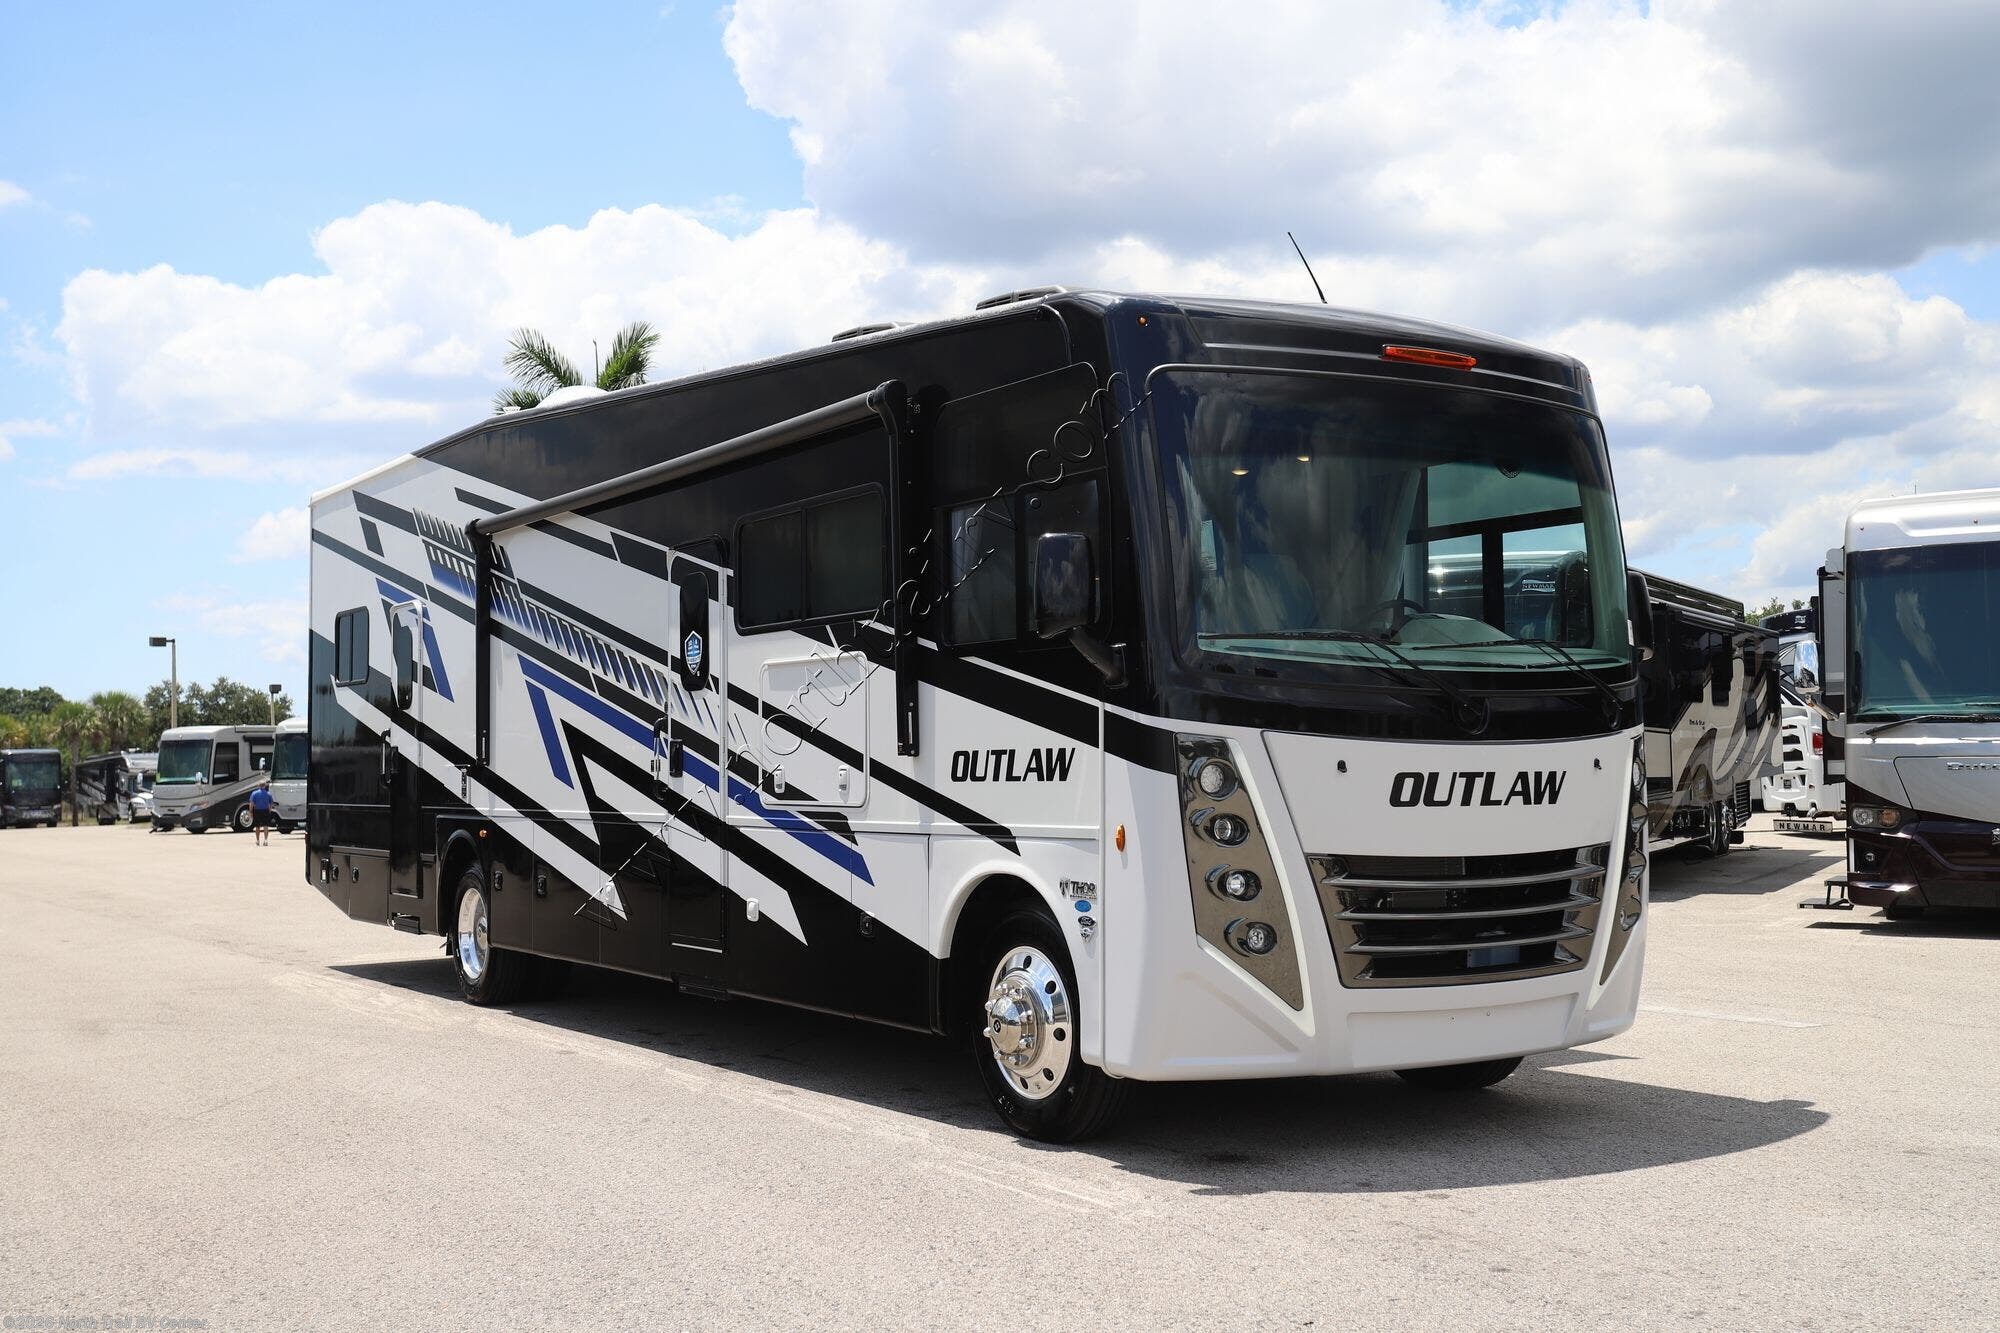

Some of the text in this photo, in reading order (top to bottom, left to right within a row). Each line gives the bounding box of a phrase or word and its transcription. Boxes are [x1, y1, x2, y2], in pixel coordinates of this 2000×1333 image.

[951, 747, 1076, 782] OUTLAW
[1389, 770, 1567, 808] OUTLAW
[1779, 822, 1825, 831] NEWMAR
[1070, 881, 1096, 896] THOR
